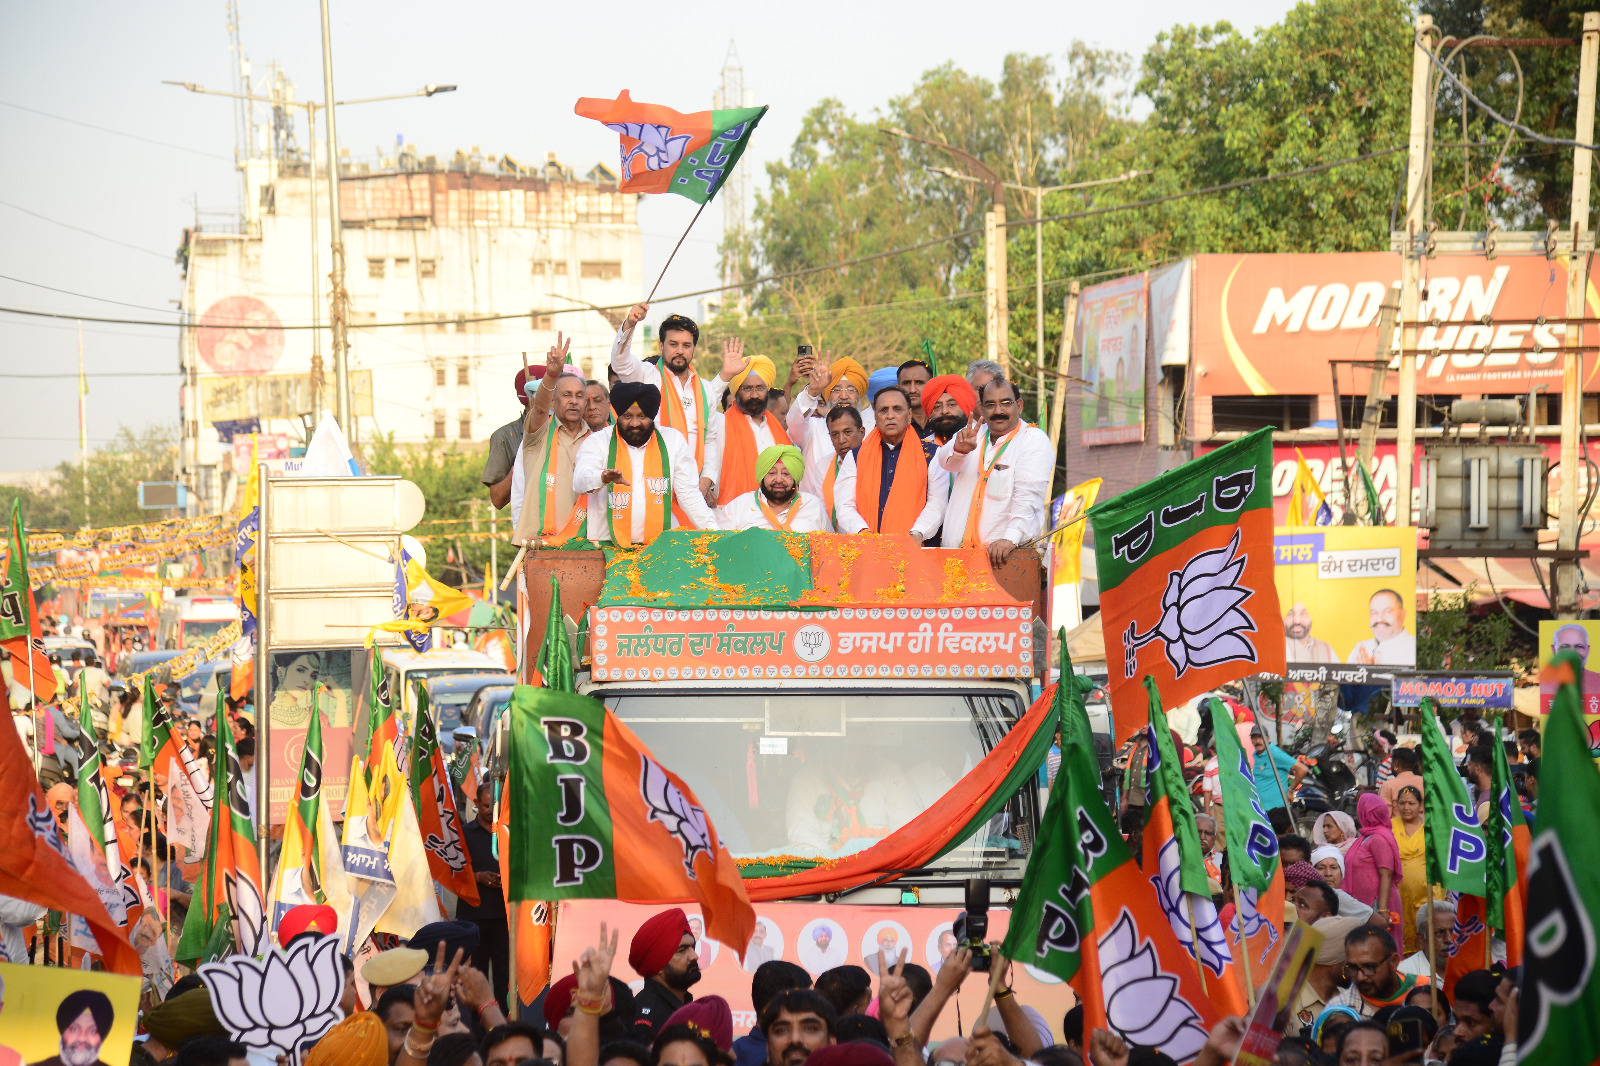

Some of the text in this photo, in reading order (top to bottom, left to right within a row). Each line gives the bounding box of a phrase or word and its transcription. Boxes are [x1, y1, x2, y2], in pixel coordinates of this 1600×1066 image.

[1252, 265, 1510, 334] MODRN
[1456, 373, 1481, 381] FAMILY
[1483, 371, 1521, 380] FOOTWEAR
[1347, 556, 1397, 573] ਦਮਦਾਰ
[616, 623, 787, 658] ਜਲੰਧਰ ਦਾ ਸੰਕਲਪ
[837, 622, 1017, 654] ਭਾਜਪਾ ਹੀ ਵਿਕਲਪ
[1288, 666, 1328, 682] ਆਦਮੀ
[1332, 667, 1369, 684] ਪਾਰਟੀ
[1399, 681, 1506, 698] MOMOS HUT
[540, 716, 603, 888] BJP
